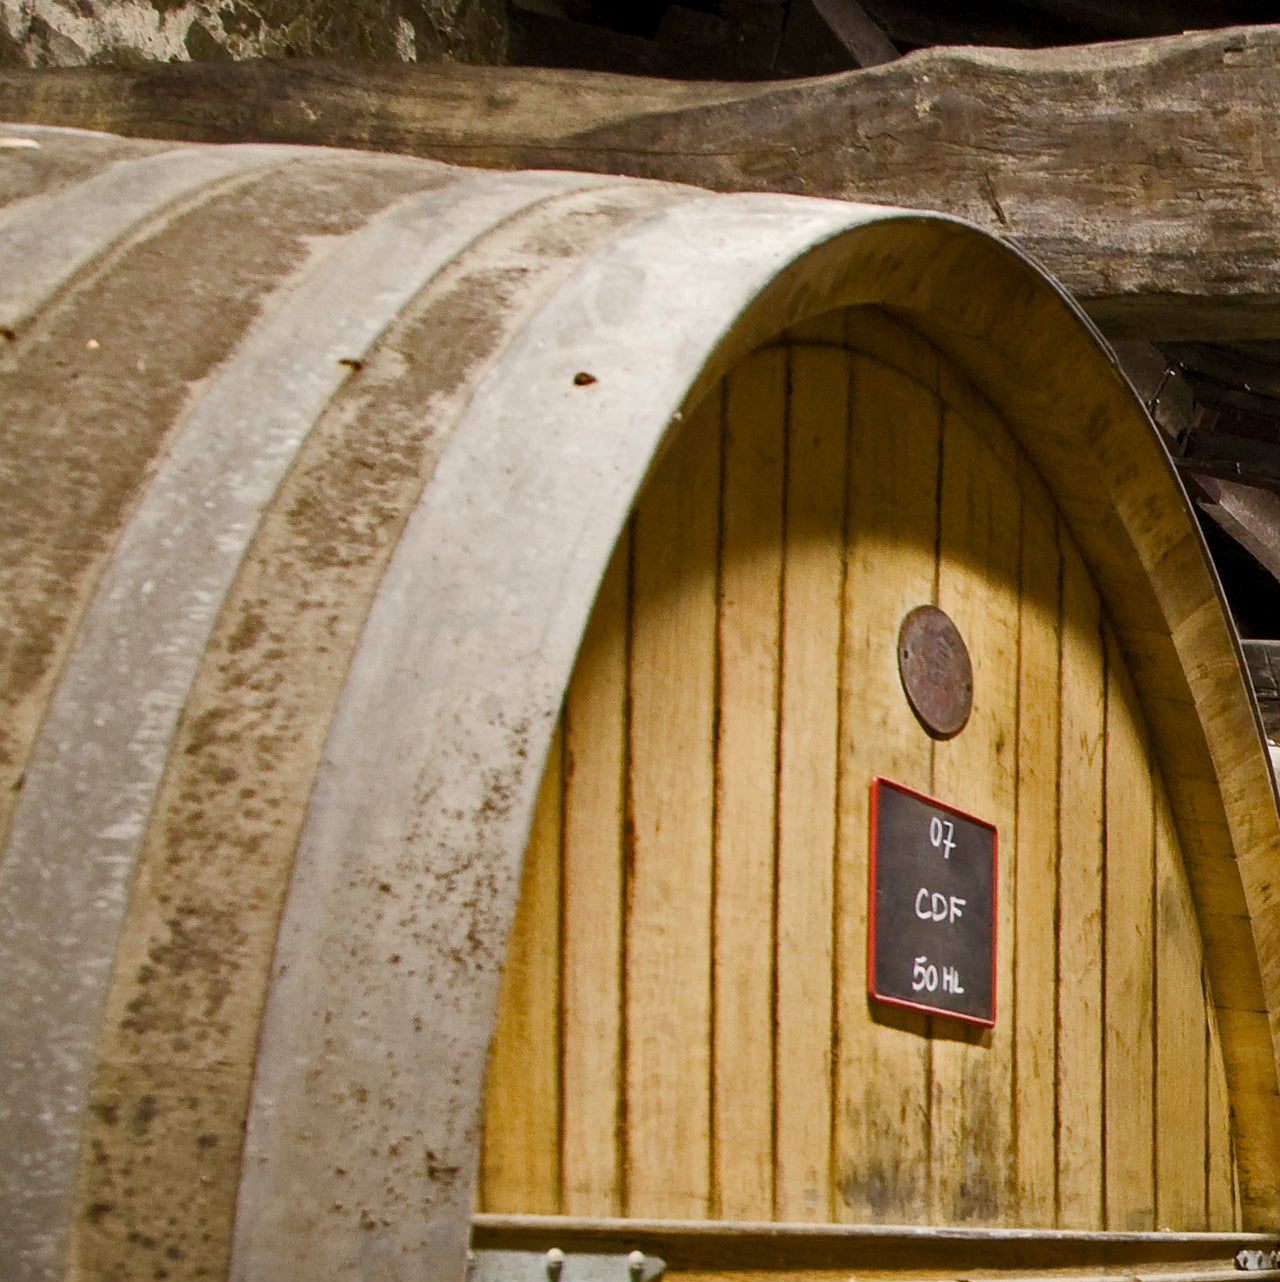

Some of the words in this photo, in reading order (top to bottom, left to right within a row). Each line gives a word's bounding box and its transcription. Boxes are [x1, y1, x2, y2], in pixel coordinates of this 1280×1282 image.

[930, 816, 956, 859] 07
[915, 887, 966, 923] CDF
[911, 956, 937, 992] 50
[942, 965, 965, 995] HL
